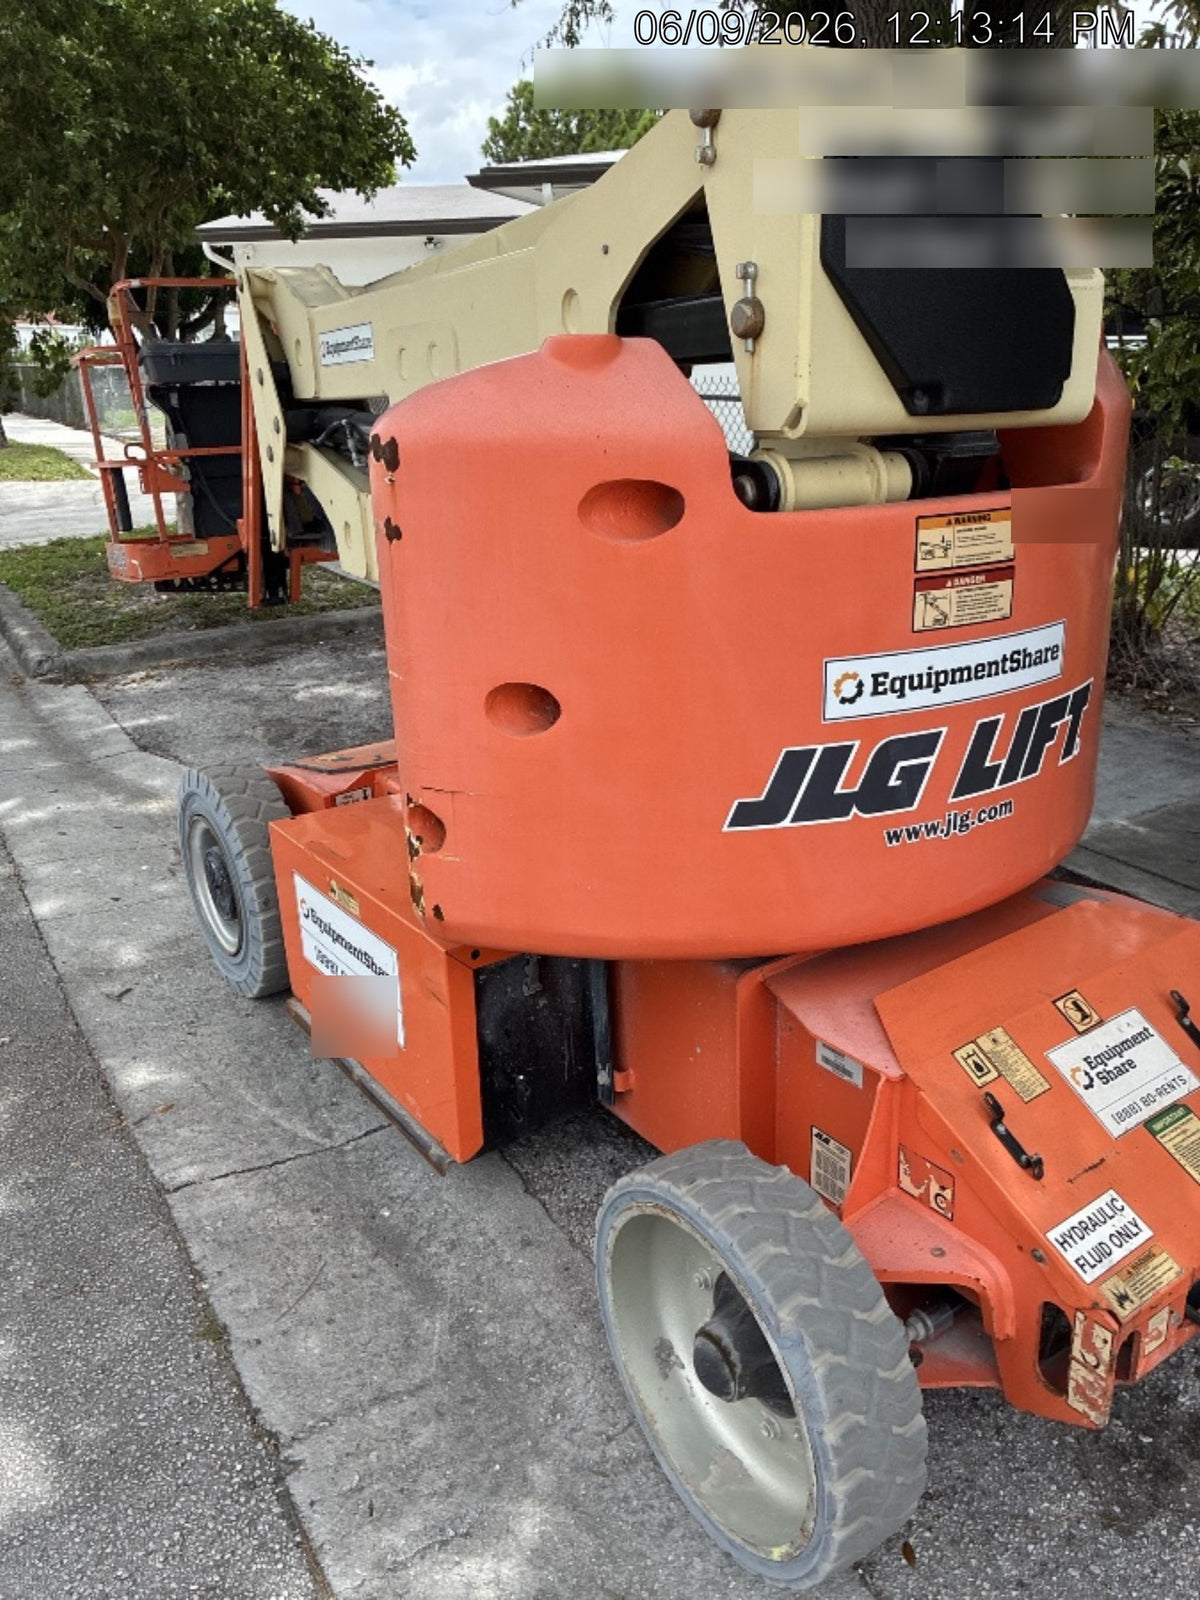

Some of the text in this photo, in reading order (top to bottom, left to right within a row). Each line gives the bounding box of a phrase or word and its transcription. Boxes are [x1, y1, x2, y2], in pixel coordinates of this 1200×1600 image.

[870, 642, 1061, 698] EquipmentShare
[722, 678, 1094, 831] JLG LIFT
[884, 798, 1014, 847] www.jlg.com
[1083, 1026, 1155, 1072] Equipment
[1096, 1056, 1137, 1086] Share
[1053, 1197, 1126, 1253] HYDRAULIC
[1074, 1219, 1144, 1276] FLUID ONLY
